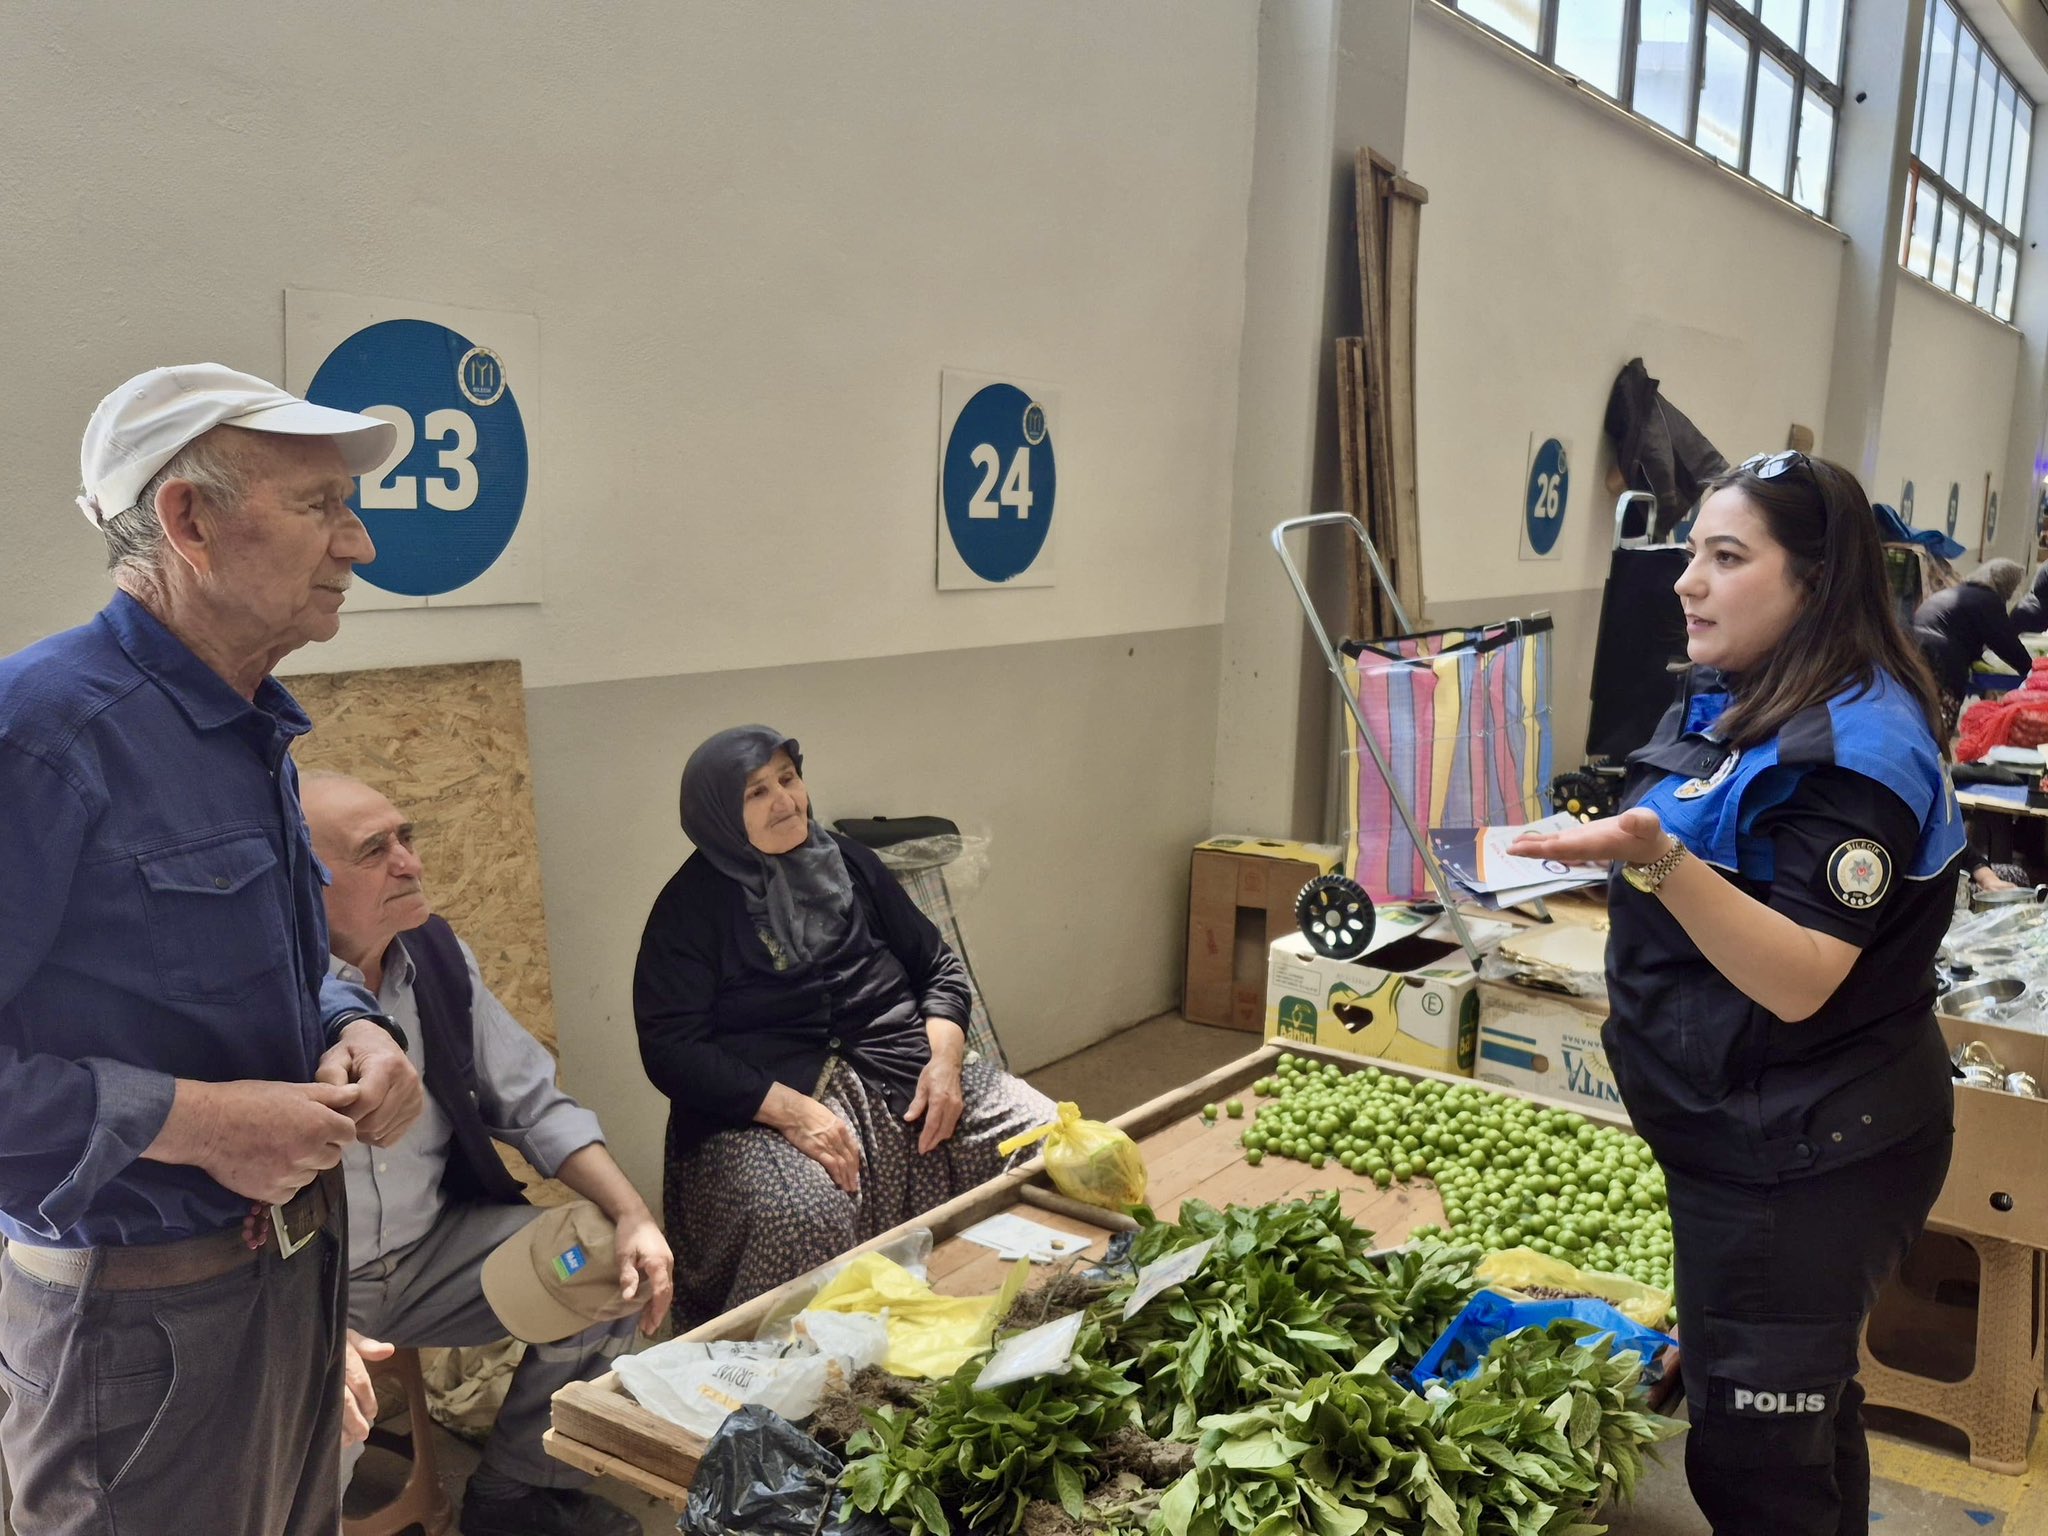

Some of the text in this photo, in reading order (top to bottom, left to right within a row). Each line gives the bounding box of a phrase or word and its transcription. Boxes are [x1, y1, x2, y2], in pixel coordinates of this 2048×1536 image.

[359, 404, 480, 512] 23
[968, 443, 1034, 519] 24
[1533, 472, 1560, 519] 26
